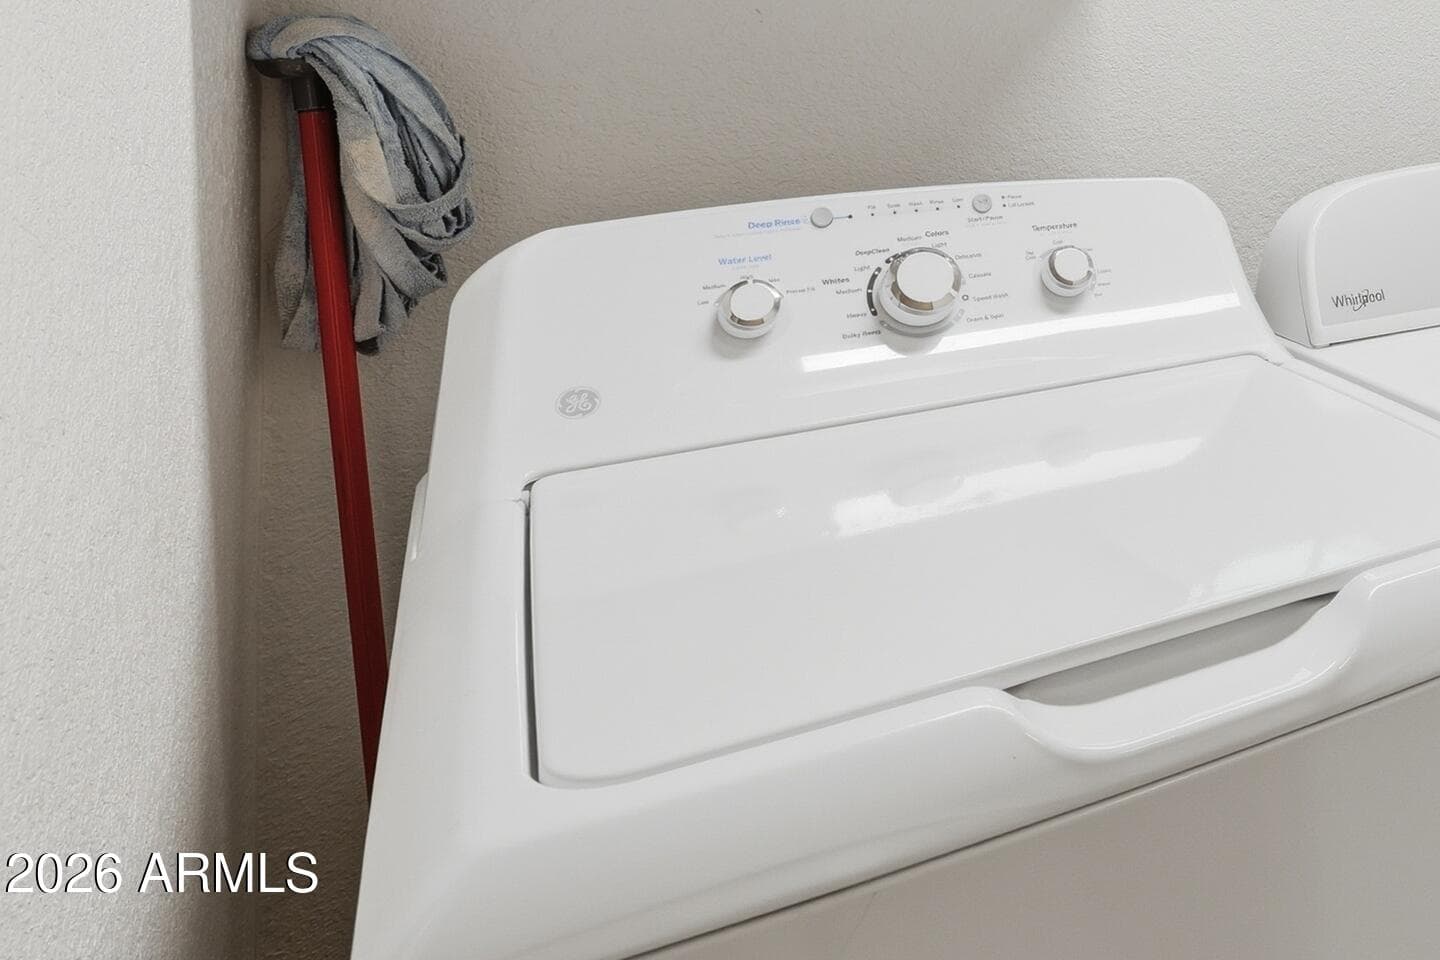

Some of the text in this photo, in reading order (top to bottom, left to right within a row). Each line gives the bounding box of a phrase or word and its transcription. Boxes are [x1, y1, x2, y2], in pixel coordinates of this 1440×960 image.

[748, 217, 801, 231] Deep Rinse
[1032, 222, 1077, 232] Temperature
[925, 229, 950, 238] Colors
[718, 253, 772, 266] Water Level
[822, 277, 850, 286] Whites
[1331, 288, 1385, 311] Whirlpool
